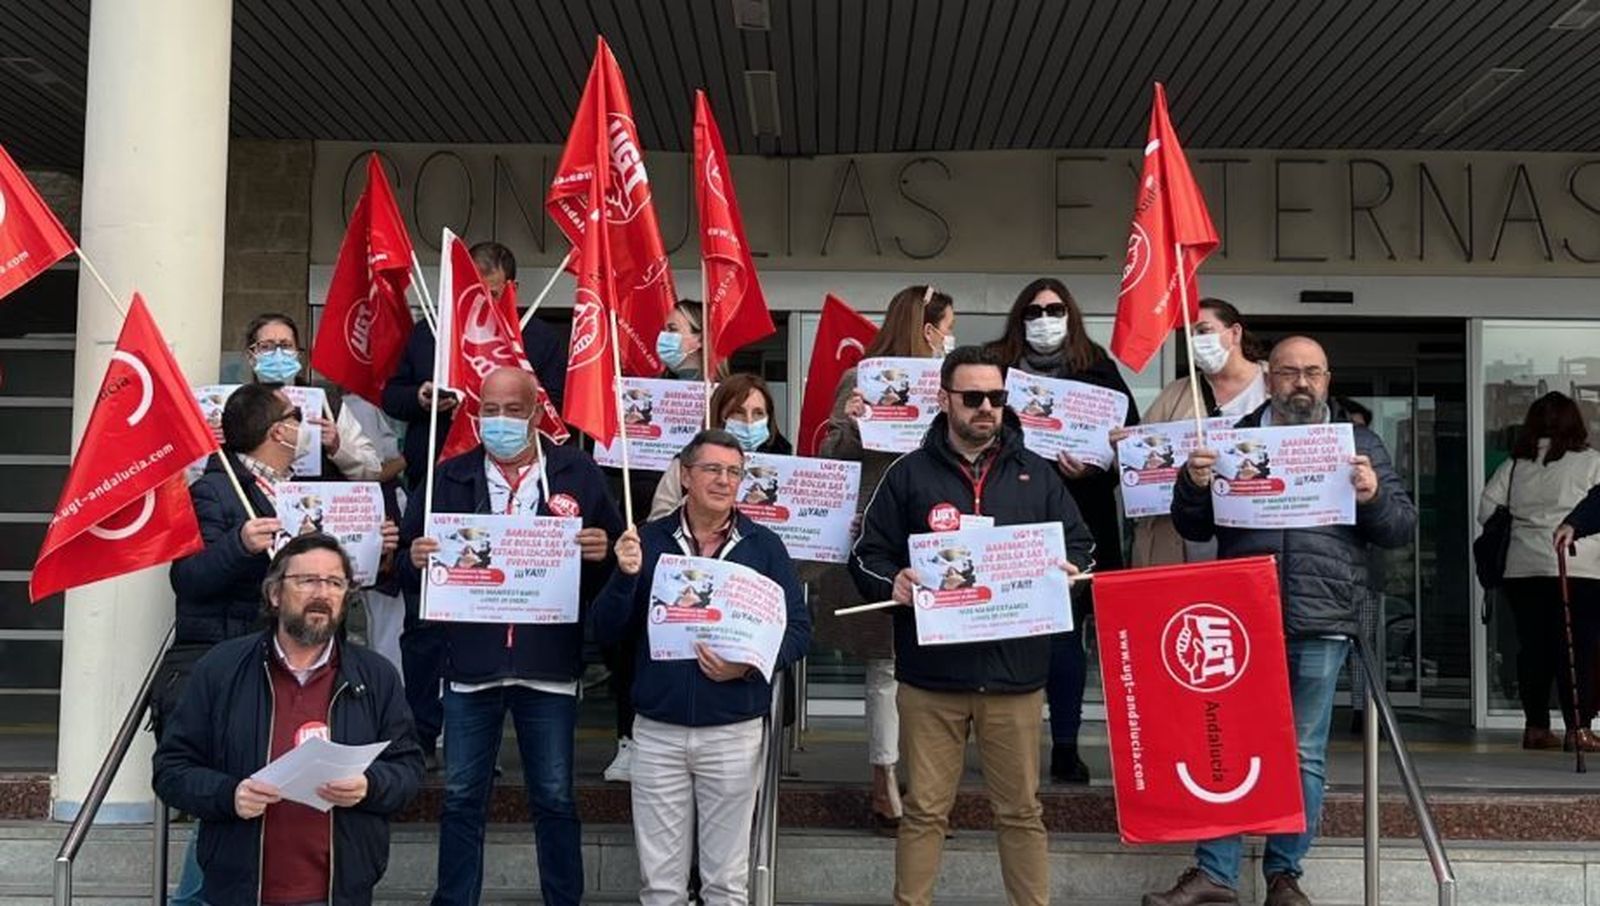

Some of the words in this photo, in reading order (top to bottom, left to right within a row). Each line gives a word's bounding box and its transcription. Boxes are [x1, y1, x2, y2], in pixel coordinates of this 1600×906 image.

[608, 119, 648, 193] UGT
[1054, 156, 1600, 263] ETERNAS
[1307, 427, 1326, 435] UGT
[820, 462, 837, 470] UGT
[793, 470, 848, 481] BAREMACIÓN
[791, 498, 843, 508] EVENTUALES
[433, 517, 454, 525] UGT
[533, 520, 552, 528] UGT
[505, 528, 563, 538] BAREMACIÓN
[1013, 530, 1031, 539] UGT
[500, 539, 512, 547] DE
[514, 539, 542, 548] BOLSA
[912, 541, 931, 549] UGT
[492, 548, 562, 558] ESTABILIZACIÓN
[505, 558, 561, 568] EVENTUALES
[1198, 616, 1236, 677] UGT
[1118, 629, 1145, 791] www.ugt-andalucia.com
